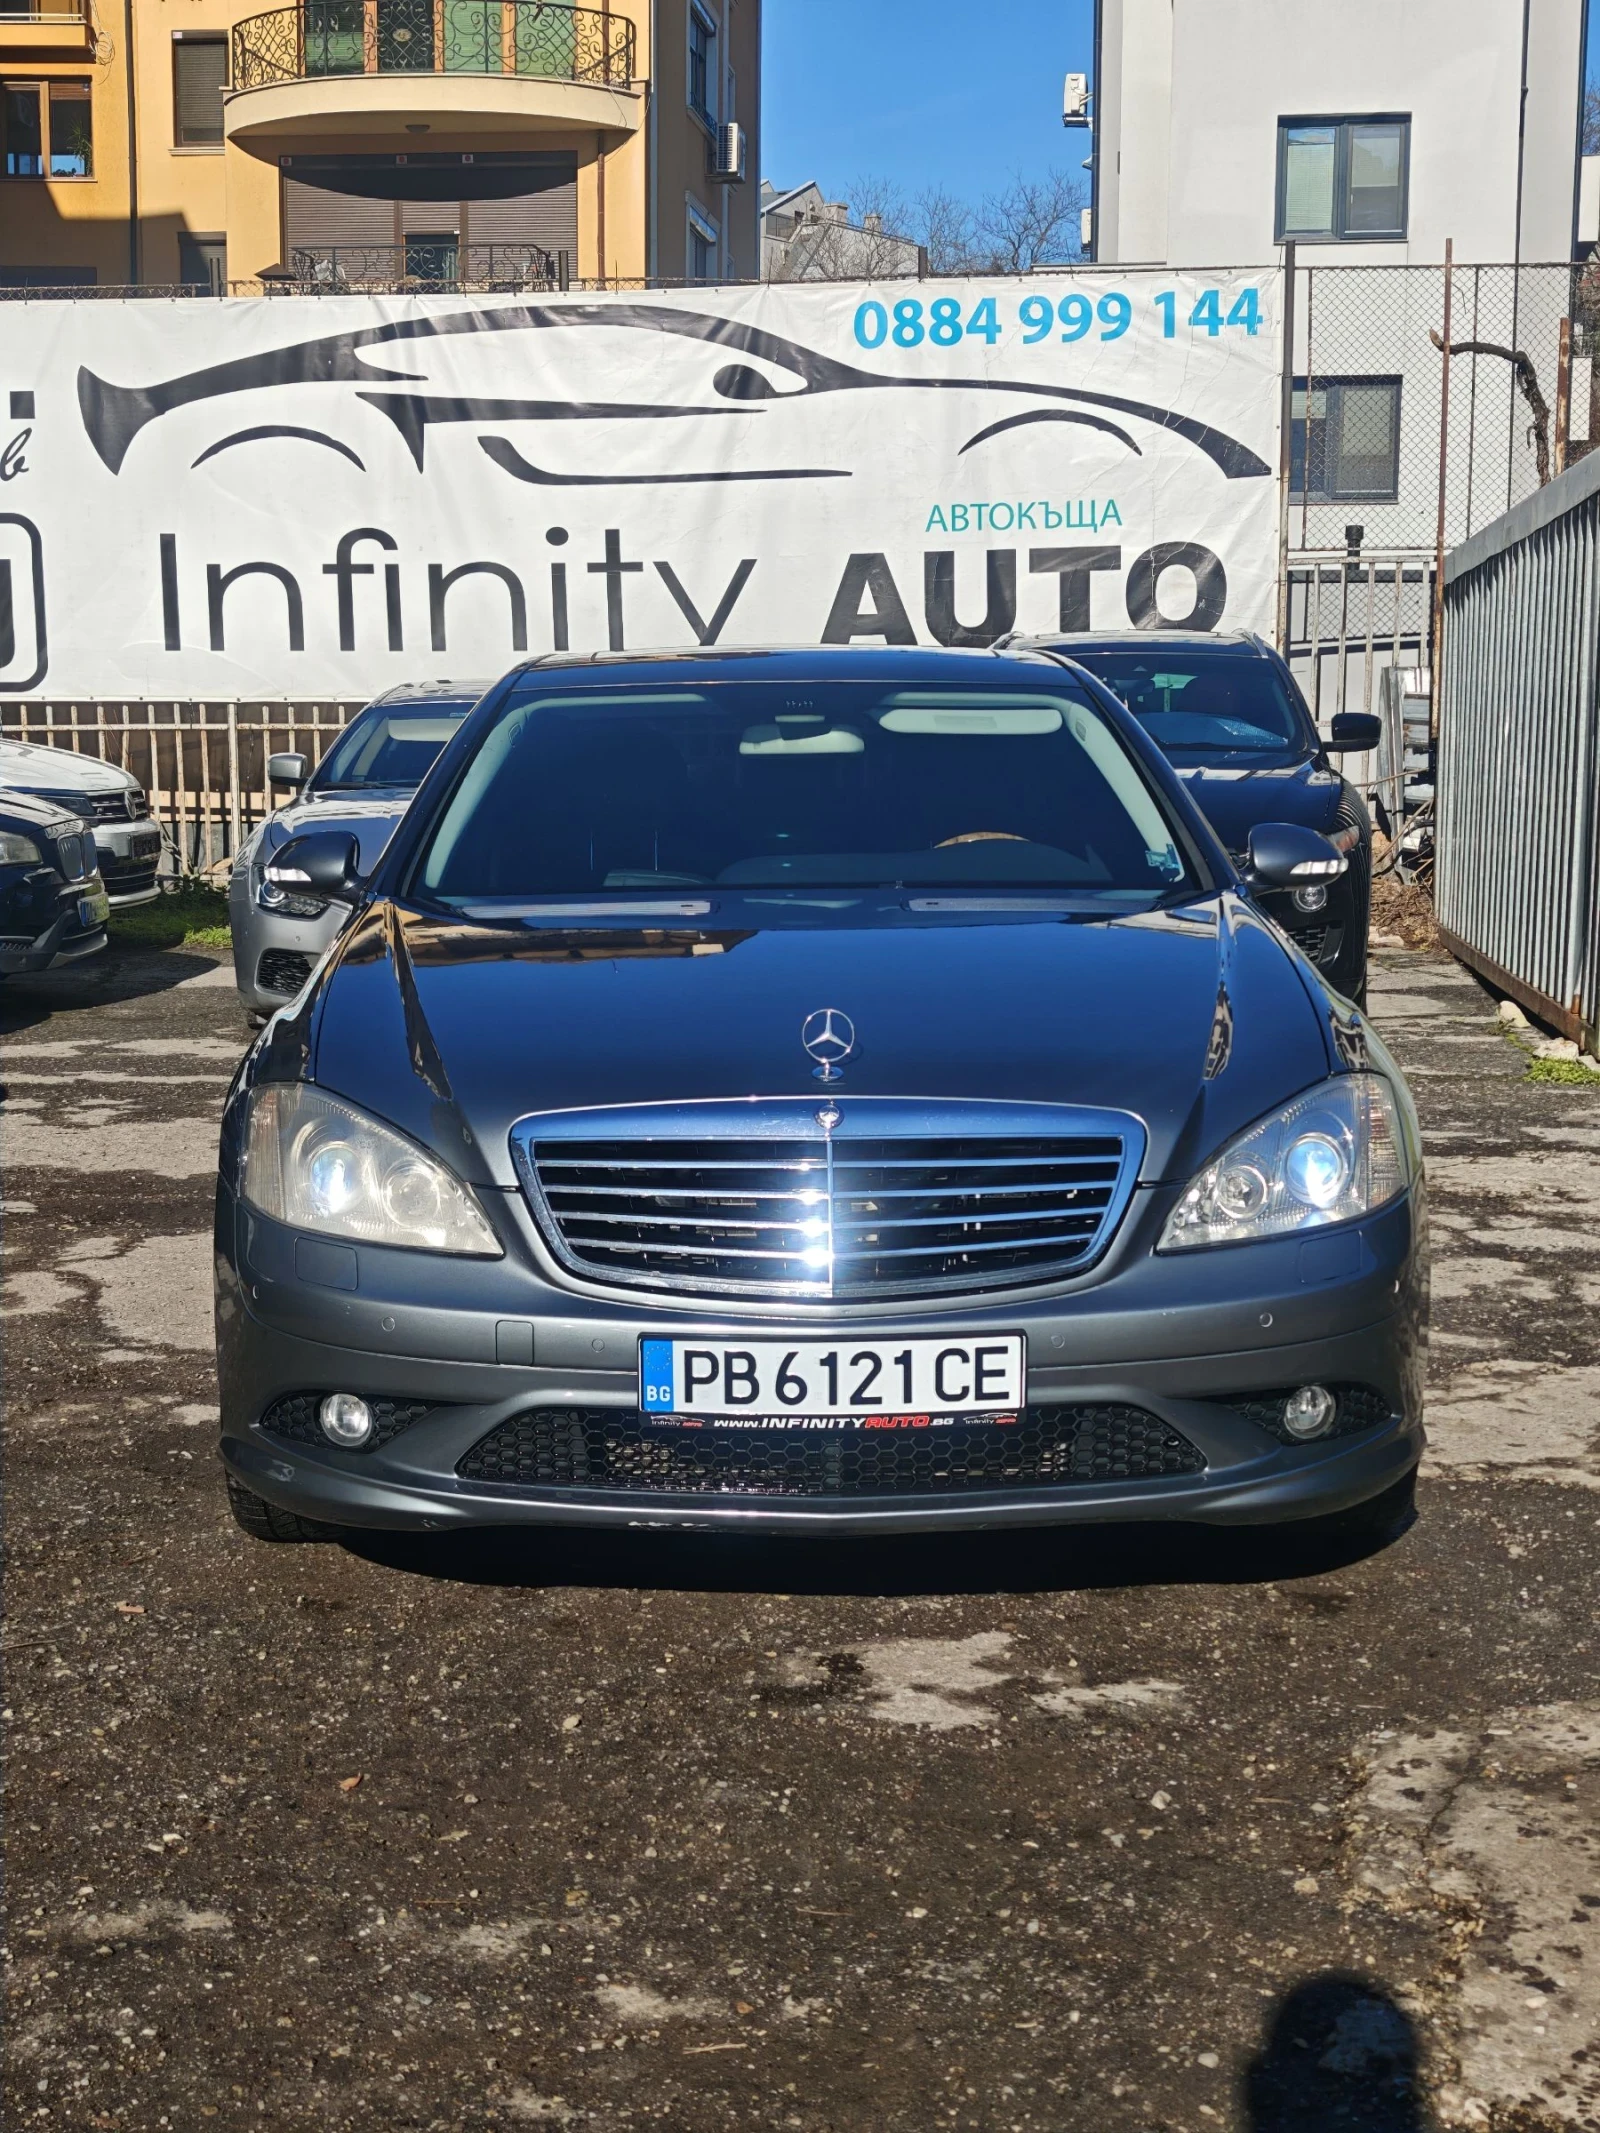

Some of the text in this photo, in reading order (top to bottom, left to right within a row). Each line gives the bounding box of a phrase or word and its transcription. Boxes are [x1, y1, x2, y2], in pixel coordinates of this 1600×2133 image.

[853, 288, 1264, 349] 0884 999 144
[926, 499, 1123, 533] АВТОКЪЩА
[159, 526, 1228, 652] Infinity AUTO
[646, 1385, 671, 1402] BG
